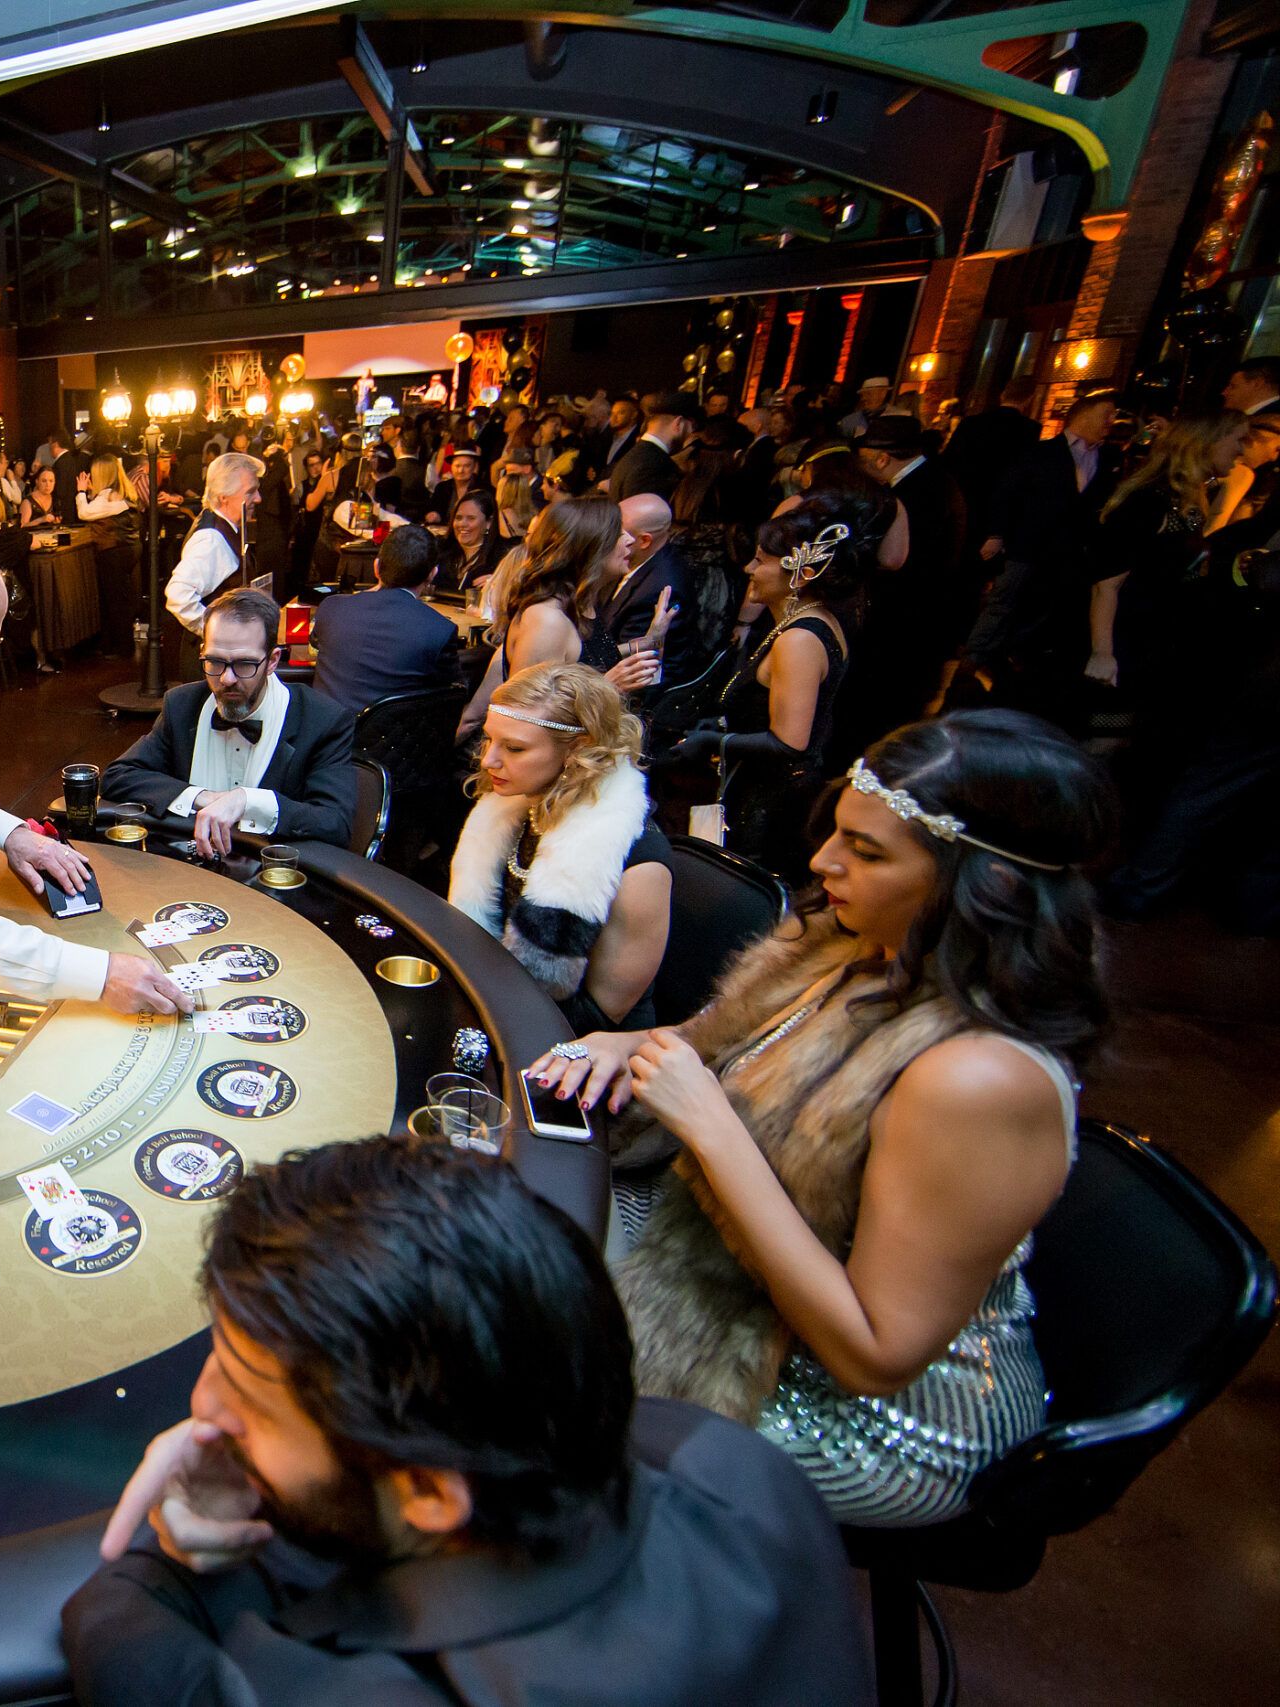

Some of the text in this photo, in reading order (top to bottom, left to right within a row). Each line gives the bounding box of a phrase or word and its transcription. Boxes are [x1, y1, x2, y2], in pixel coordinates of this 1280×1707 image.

[72, 1060, 136, 1119] LACKJACK
[122, 1034, 149, 1062] PAYS
[219, 1062, 246, 1072] School
[77, 1146, 95, 1160] 2
[91, 1128, 122, 1149] TO
[120, 1119, 136, 1131] 1
[145, 1036, 196, 1107] INSURANCE
[267, 1080, 292, 1112] Reserved
[42, 1124, 86, 1154] Dealer
[152, 1136, 169, 1151] Bell
[169, 1131, 203, 1141] School
[200, 1163, 239, 1198] Reserved
[84, 1193, 118, 1208] School
[75, 1241, 133, 1271] Reserved
